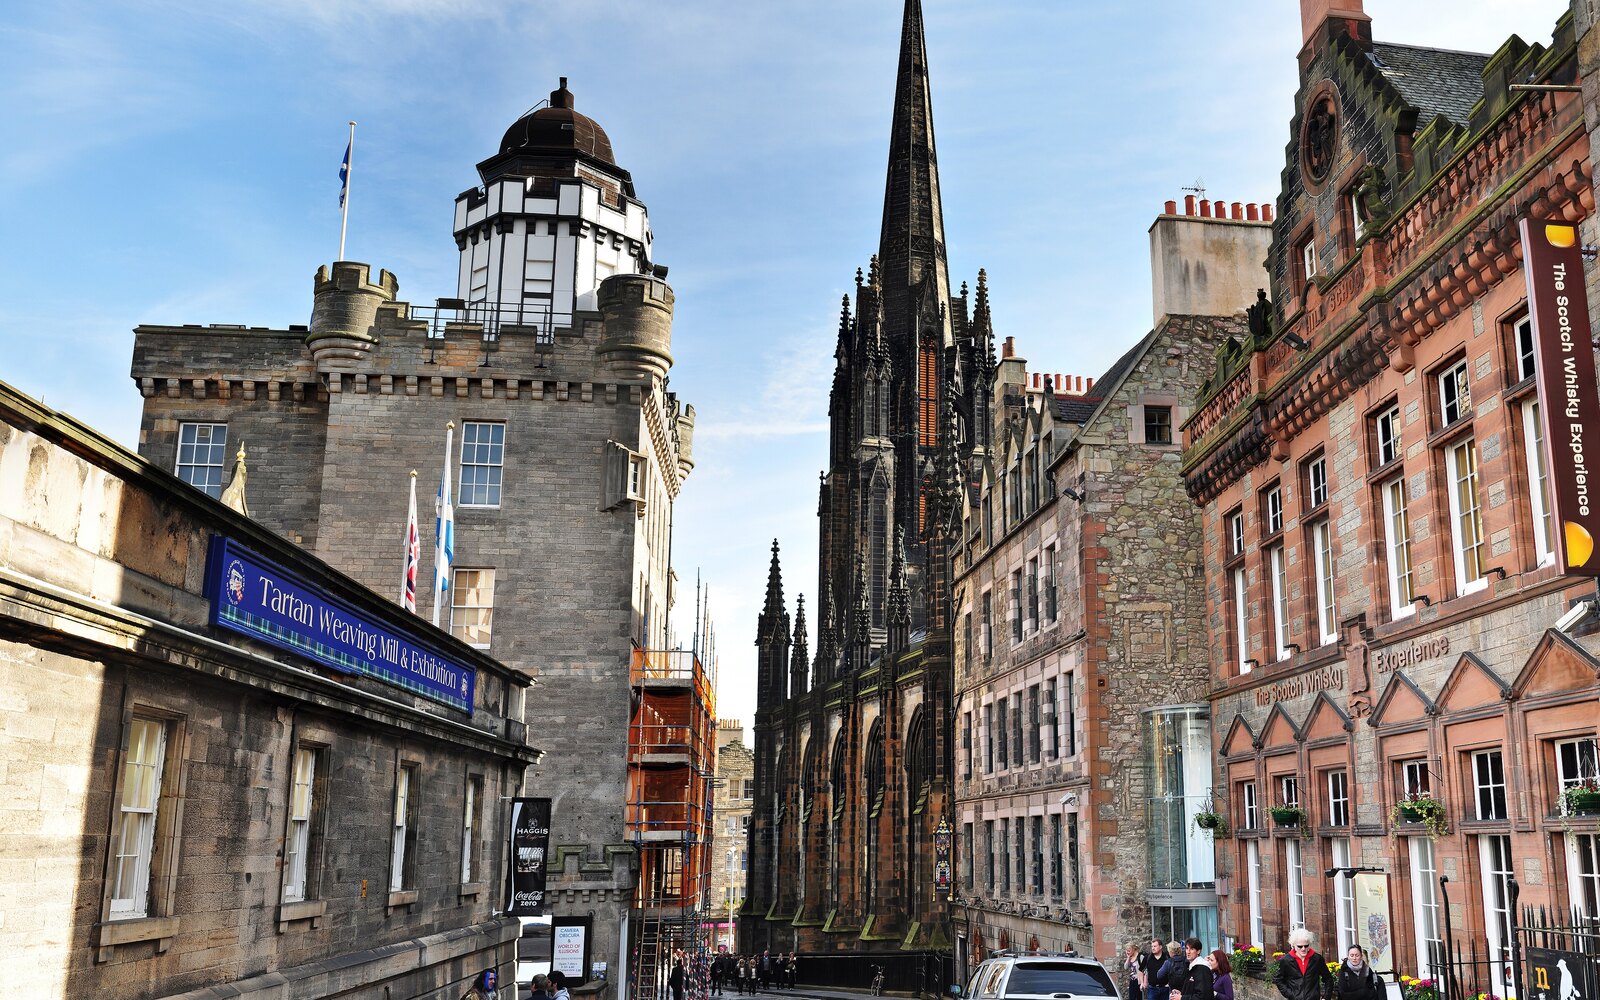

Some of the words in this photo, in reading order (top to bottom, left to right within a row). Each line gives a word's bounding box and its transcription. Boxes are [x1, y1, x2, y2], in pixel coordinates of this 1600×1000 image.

[1552, 263, 1565, 291] The
[1556, 295, 1572, 352] Scotch
[1562, 356, 1579, 418] Whisky
[1568, 422, 1590, 517] Experience
[258, 575, 314, 627] Tartan
[319, 606, 377, 661] Weaving
[379, 635, 399, 664] Mill
[400, 647, 409, 669] &
[411, 650, 458, 689] Exhibition
[1255, 687, 1270, 707] The
[1271, 680, 1303, 702] Scotch
[1304, 666, 1343, 694] Whisky
[1376, 634, 1450, 675] Experience
[516, 827, 549, 835] HAGGIS
